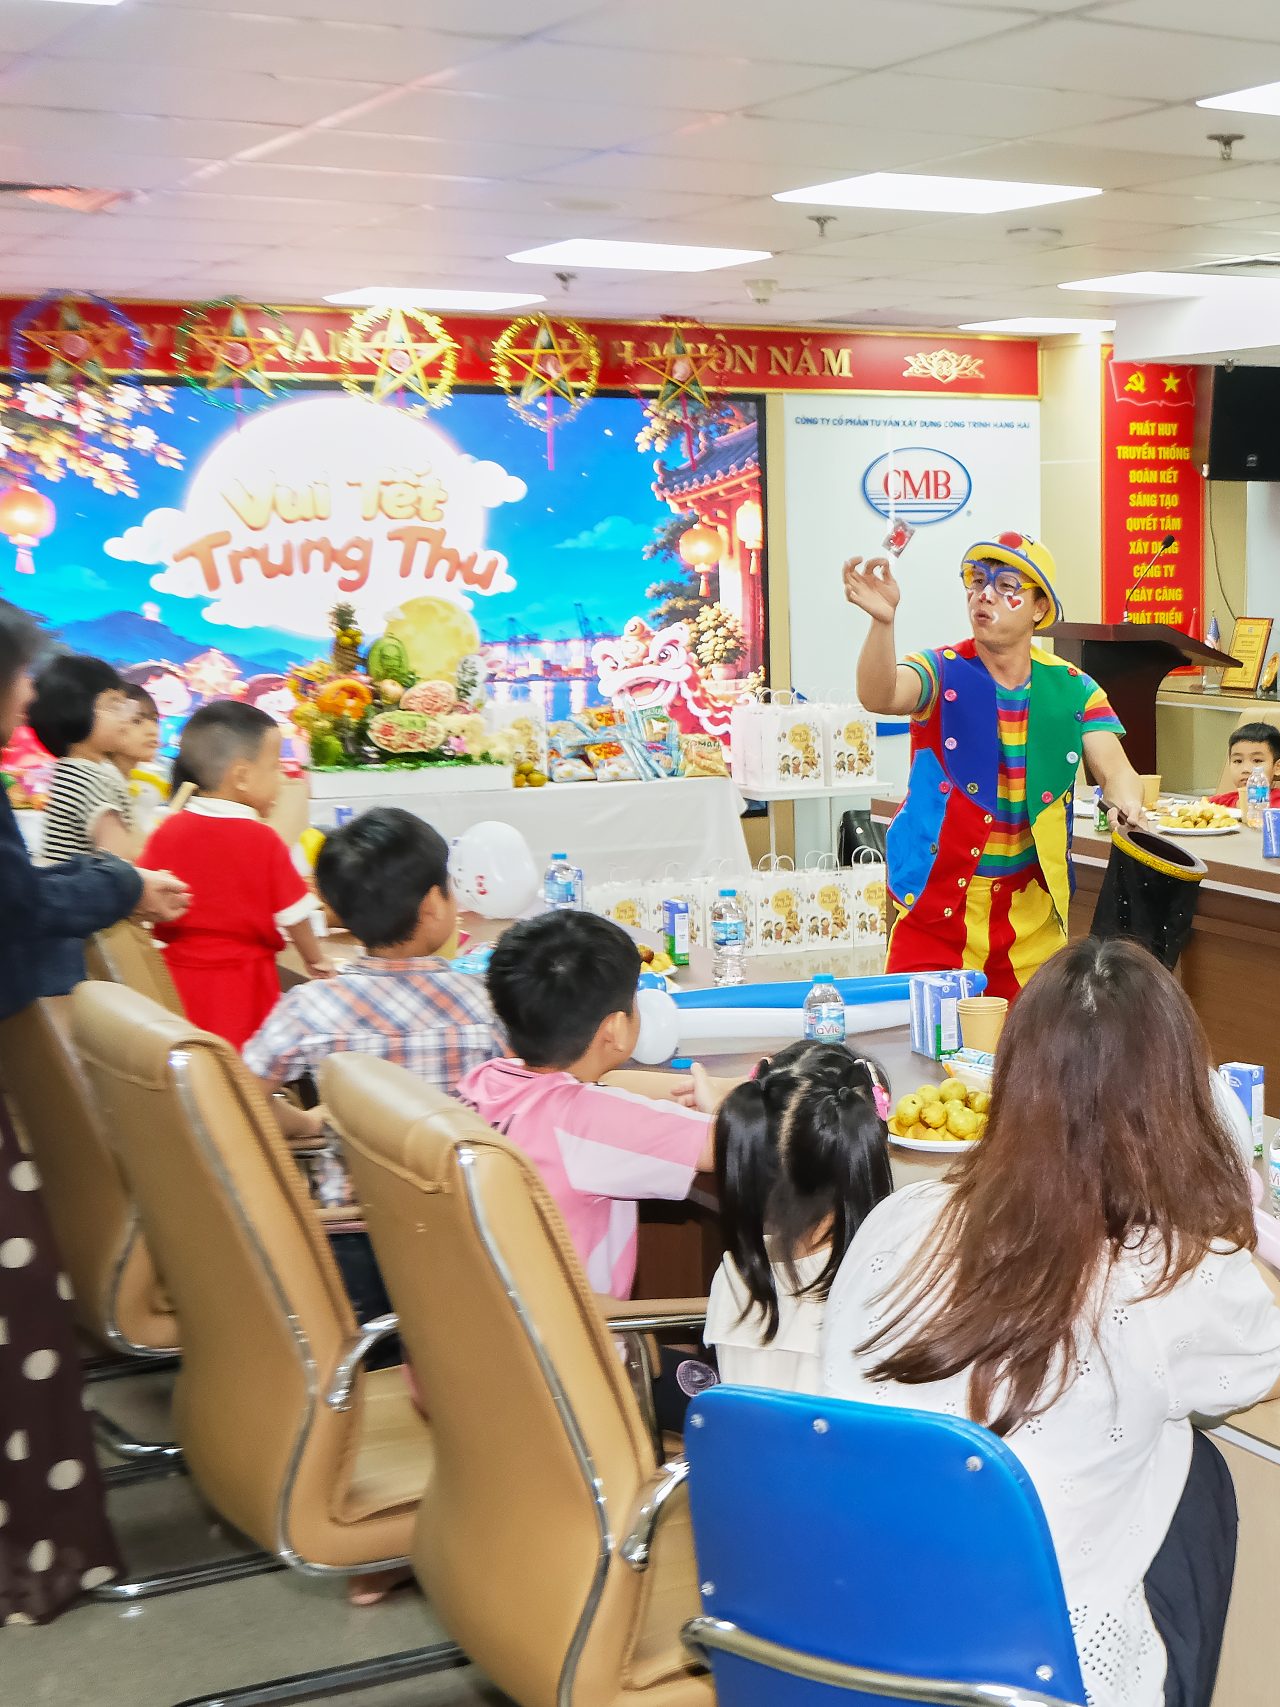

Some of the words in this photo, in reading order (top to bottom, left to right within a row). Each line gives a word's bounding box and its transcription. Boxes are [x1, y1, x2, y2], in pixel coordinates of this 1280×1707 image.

[767, 338, 853, 378] NĂM
[1129, 420, 1156, 436] PHÁT
[1157, 422, 1178, 436] HUY
[1157, 443, 1191, 460] THỐNG
[1159, 466, 1178, 483] KẾT
[882, 468, 951, 500] CMB
[219, 467, 332, 531] Vui
[345, 461, 449, 522] Tết
[1129, 491, 1157, 507] SÁNG
[1159, 493, 1179, 509] TẠO
[1126, 513, 1158, 532] QUYẾT
[1159, 514, 1182, 530] TÂM
[1129, 539, 1149, 554] XÂY
[172, 530, 373, 592] Trung
[387, 526, 499, 590] Thu
[1133, 563, 1162, 578] CÔNG
[1162, 564, 1175, 577] TY
[1126, 586, 1153, 601] NGÀY
[1155, 586, 1184, 601] CÀNG
[1127, 610, 1152, 624] PHÁT
